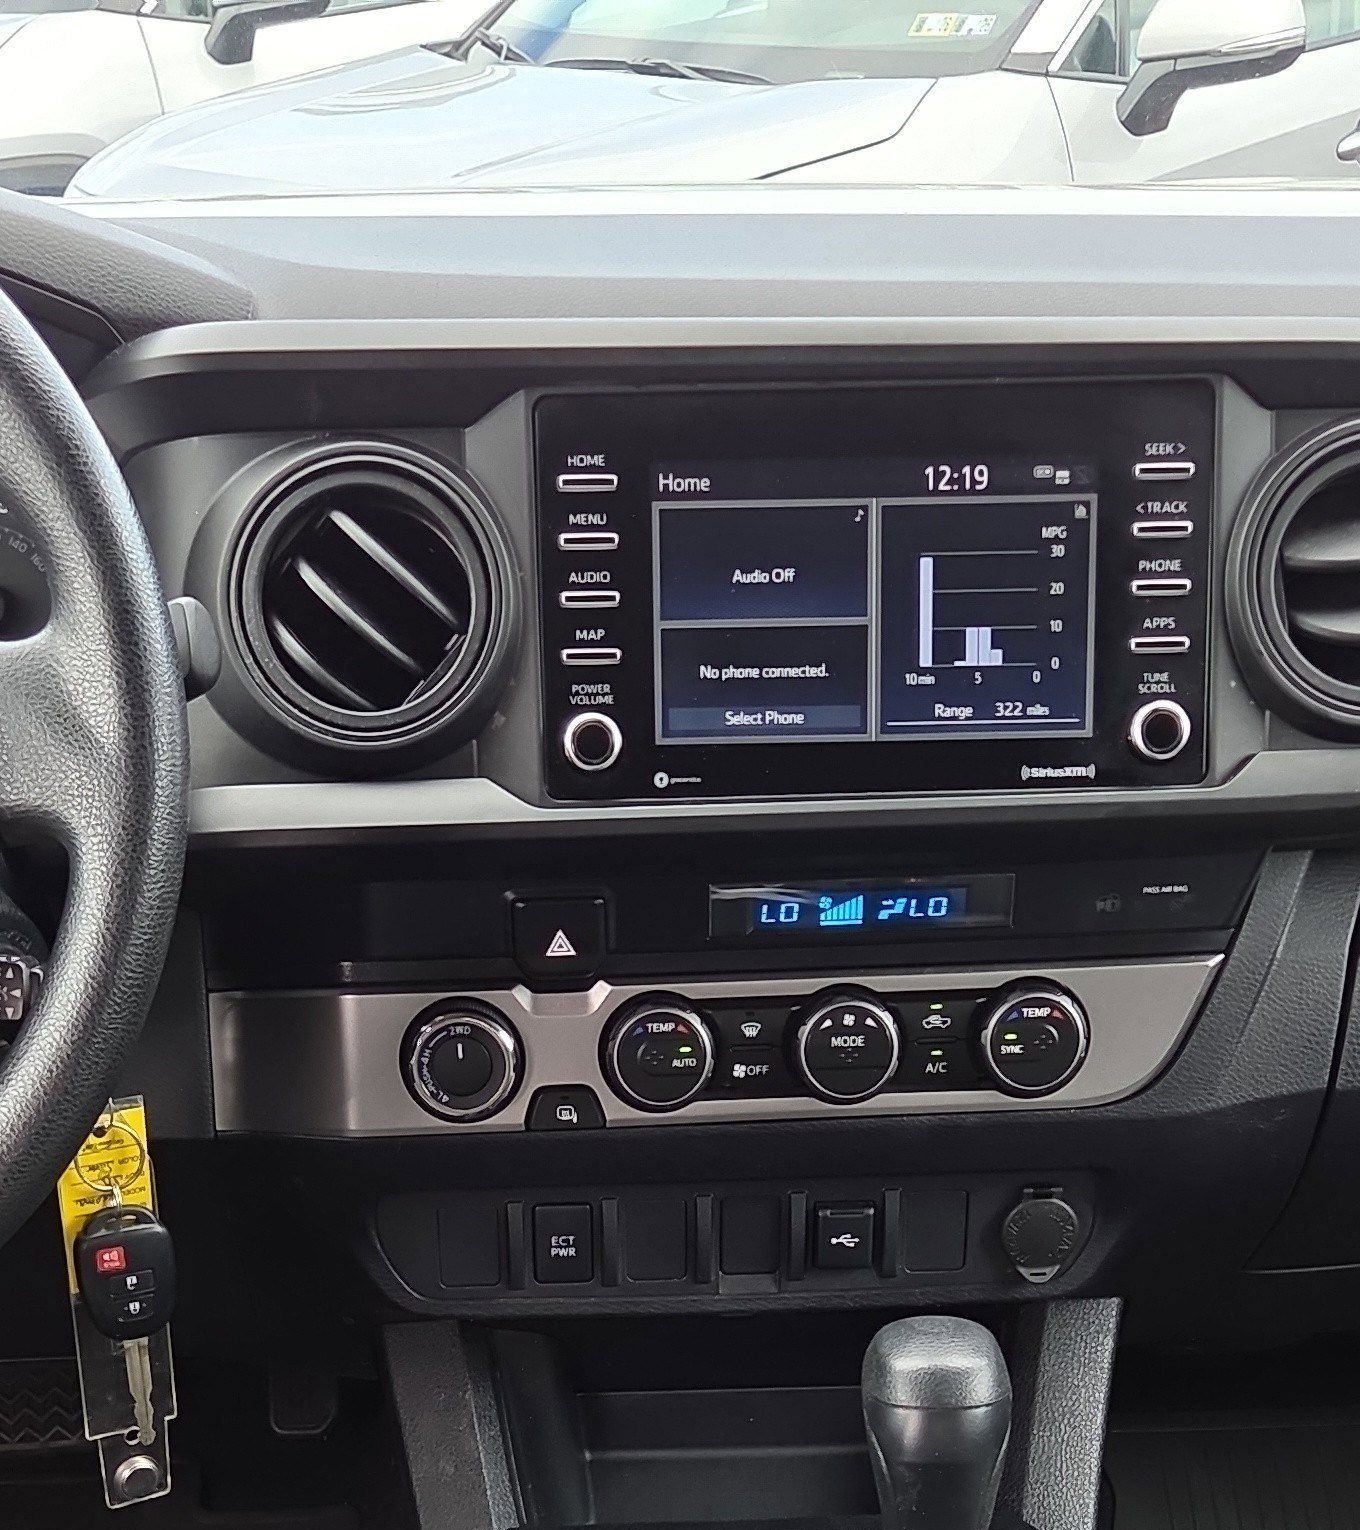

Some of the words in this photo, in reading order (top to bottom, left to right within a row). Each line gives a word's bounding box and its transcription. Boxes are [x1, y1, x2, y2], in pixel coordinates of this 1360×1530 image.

[1144, 443, 1175, 456] SEEK
[567, 454, 606, 467] HOME
[658, 473, 711, 493] Home
[924, 465, 989, 491] 12:19
[1146, 501, 1188, 514] TRACK
[568, 514, 607, 525] MENU
[1041, 526, 1067, 539] MPG
[8, 536, 28, 553] 140
[1050, 545, 1066, 558] 30
[1138, 559, 1182, 572] PHONE
[568, 571, 611, 583] AUDIO
[732, 569, 770, 584] Audio
[771, 568, 796, 583] Off
[1049, 582, 1065, 595] 20
[1049, 620, 1063, 632] 10
[1142, 616, 1176, 630] APPS
[575, 629, 606, 641] MAP
[1050, 657, 1060, 670] 0
[699, 665, 720, 680] No
[721, 665, 760, 681] phone
[761, 663, 830, 678] connected.
[974, 671, 982, 684] 5
[1032, 670, 1041, 683] 0
[1143, 672, 1170, 683] TUNE
[572, 683, 611, 695] POWER
[1138, 683, 1177, 695] SCROLL
[569, 694, 615, 706] VOLUME
[934, 704, 974, 719] Range
[994, 702, 1024, 717] 322
[1026, 704, 1050, 716] miles
[725, 710, 763, 726] Select
[764, 710, 806, 725] Phone
[1021, 1006, 1052, 1018] TEMP
[449, 1025, 472, 1037] 2WD
[646, 1022, 676, 1034] TEMP
[830, 1035, 866, 1048] MODE
[1000, 1044, 1024, 1055] SYNC
[671, 1058, 697, 1068] AUTO
[925, 1062, 948, 1074] A/C
[747, 1064, 770, 1076] OFF
[551, 1235, 576, 1246] ECT
[550, 1247, 577, 1258] PWR
